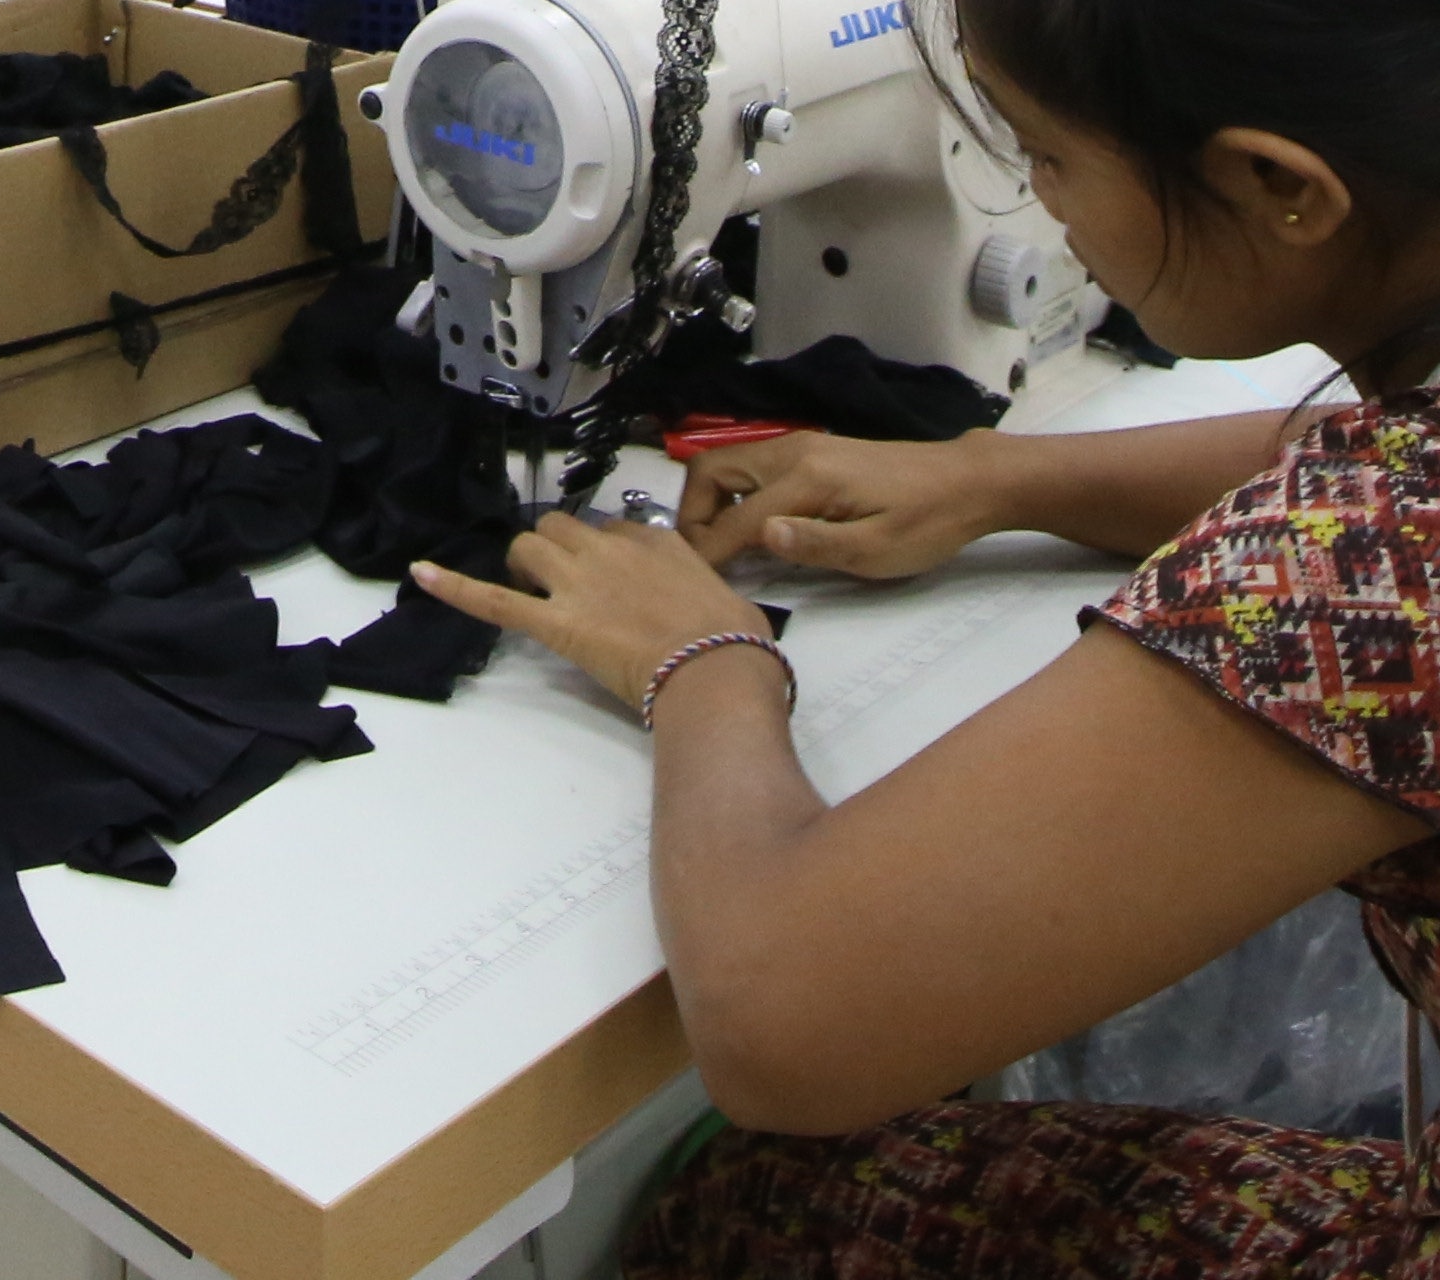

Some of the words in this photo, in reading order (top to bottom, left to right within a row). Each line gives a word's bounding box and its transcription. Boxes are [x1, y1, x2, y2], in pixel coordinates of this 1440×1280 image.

[435, 121, 536, 166] JUKI
[415, 986, 436, 1000] 2
[464, 954, 484, 968] 3
